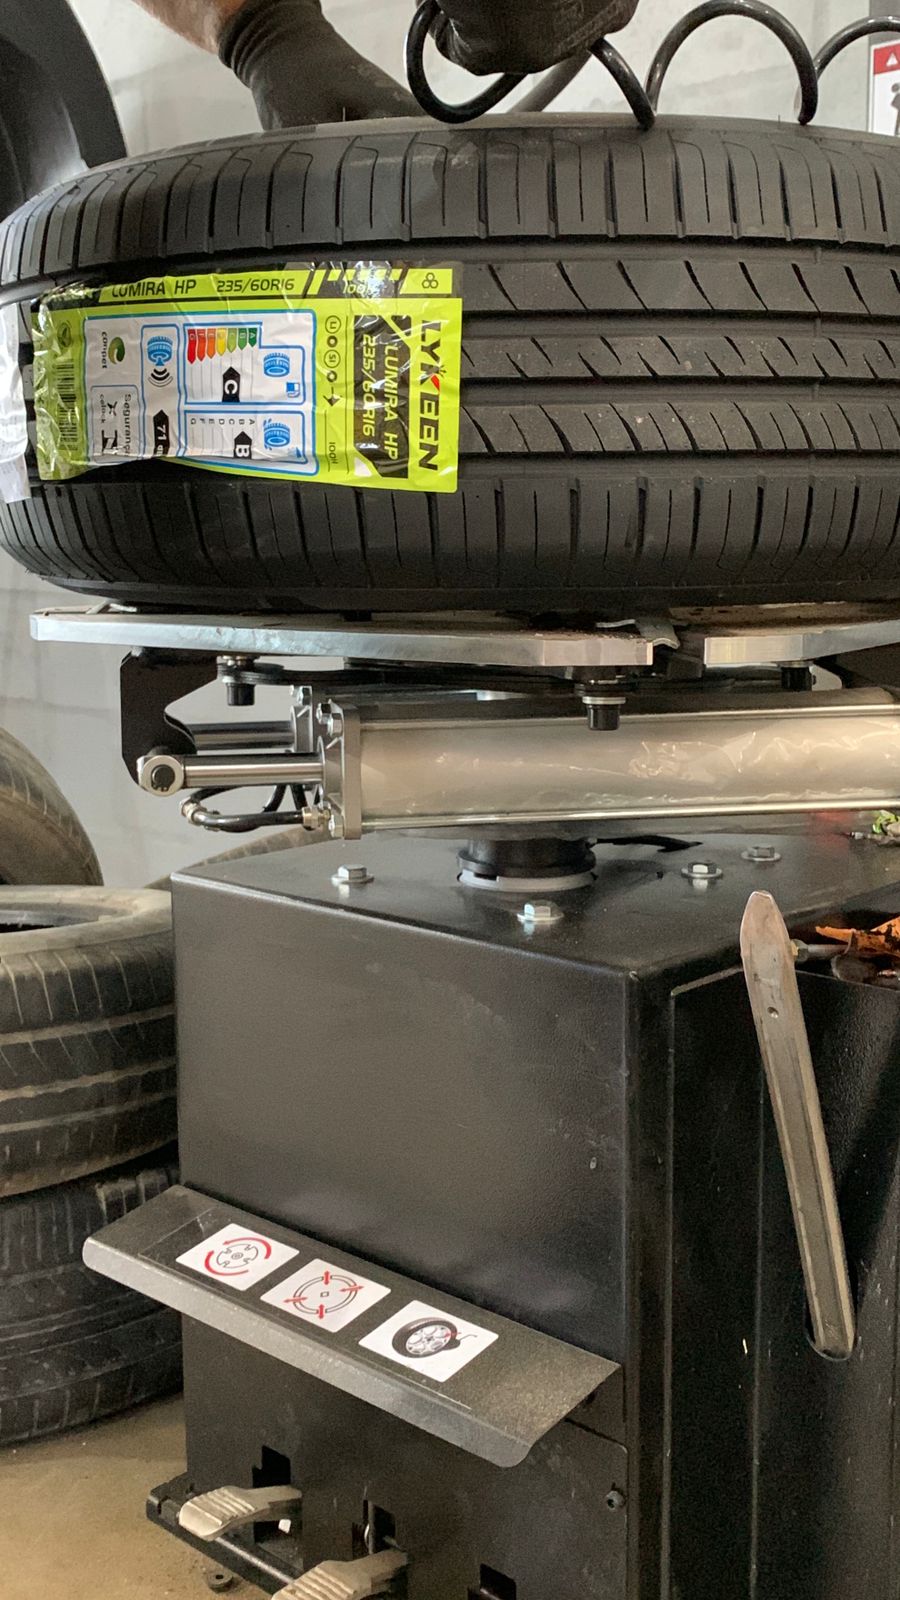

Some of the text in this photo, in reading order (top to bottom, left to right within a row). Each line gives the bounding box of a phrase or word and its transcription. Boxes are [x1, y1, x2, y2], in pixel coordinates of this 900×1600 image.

[111, 277, 295, 298] LUMIRA HP 235/60R16
[225, 379, 238, 394] C
[361, 334, 377, 437] 235/60R16
[418, 320, 442, 471] LYKEEN
[384, 345, 398, 460] LUMIRA HP
[157, 424, 167, 440] 71
[236, 444, 249, 457] B
